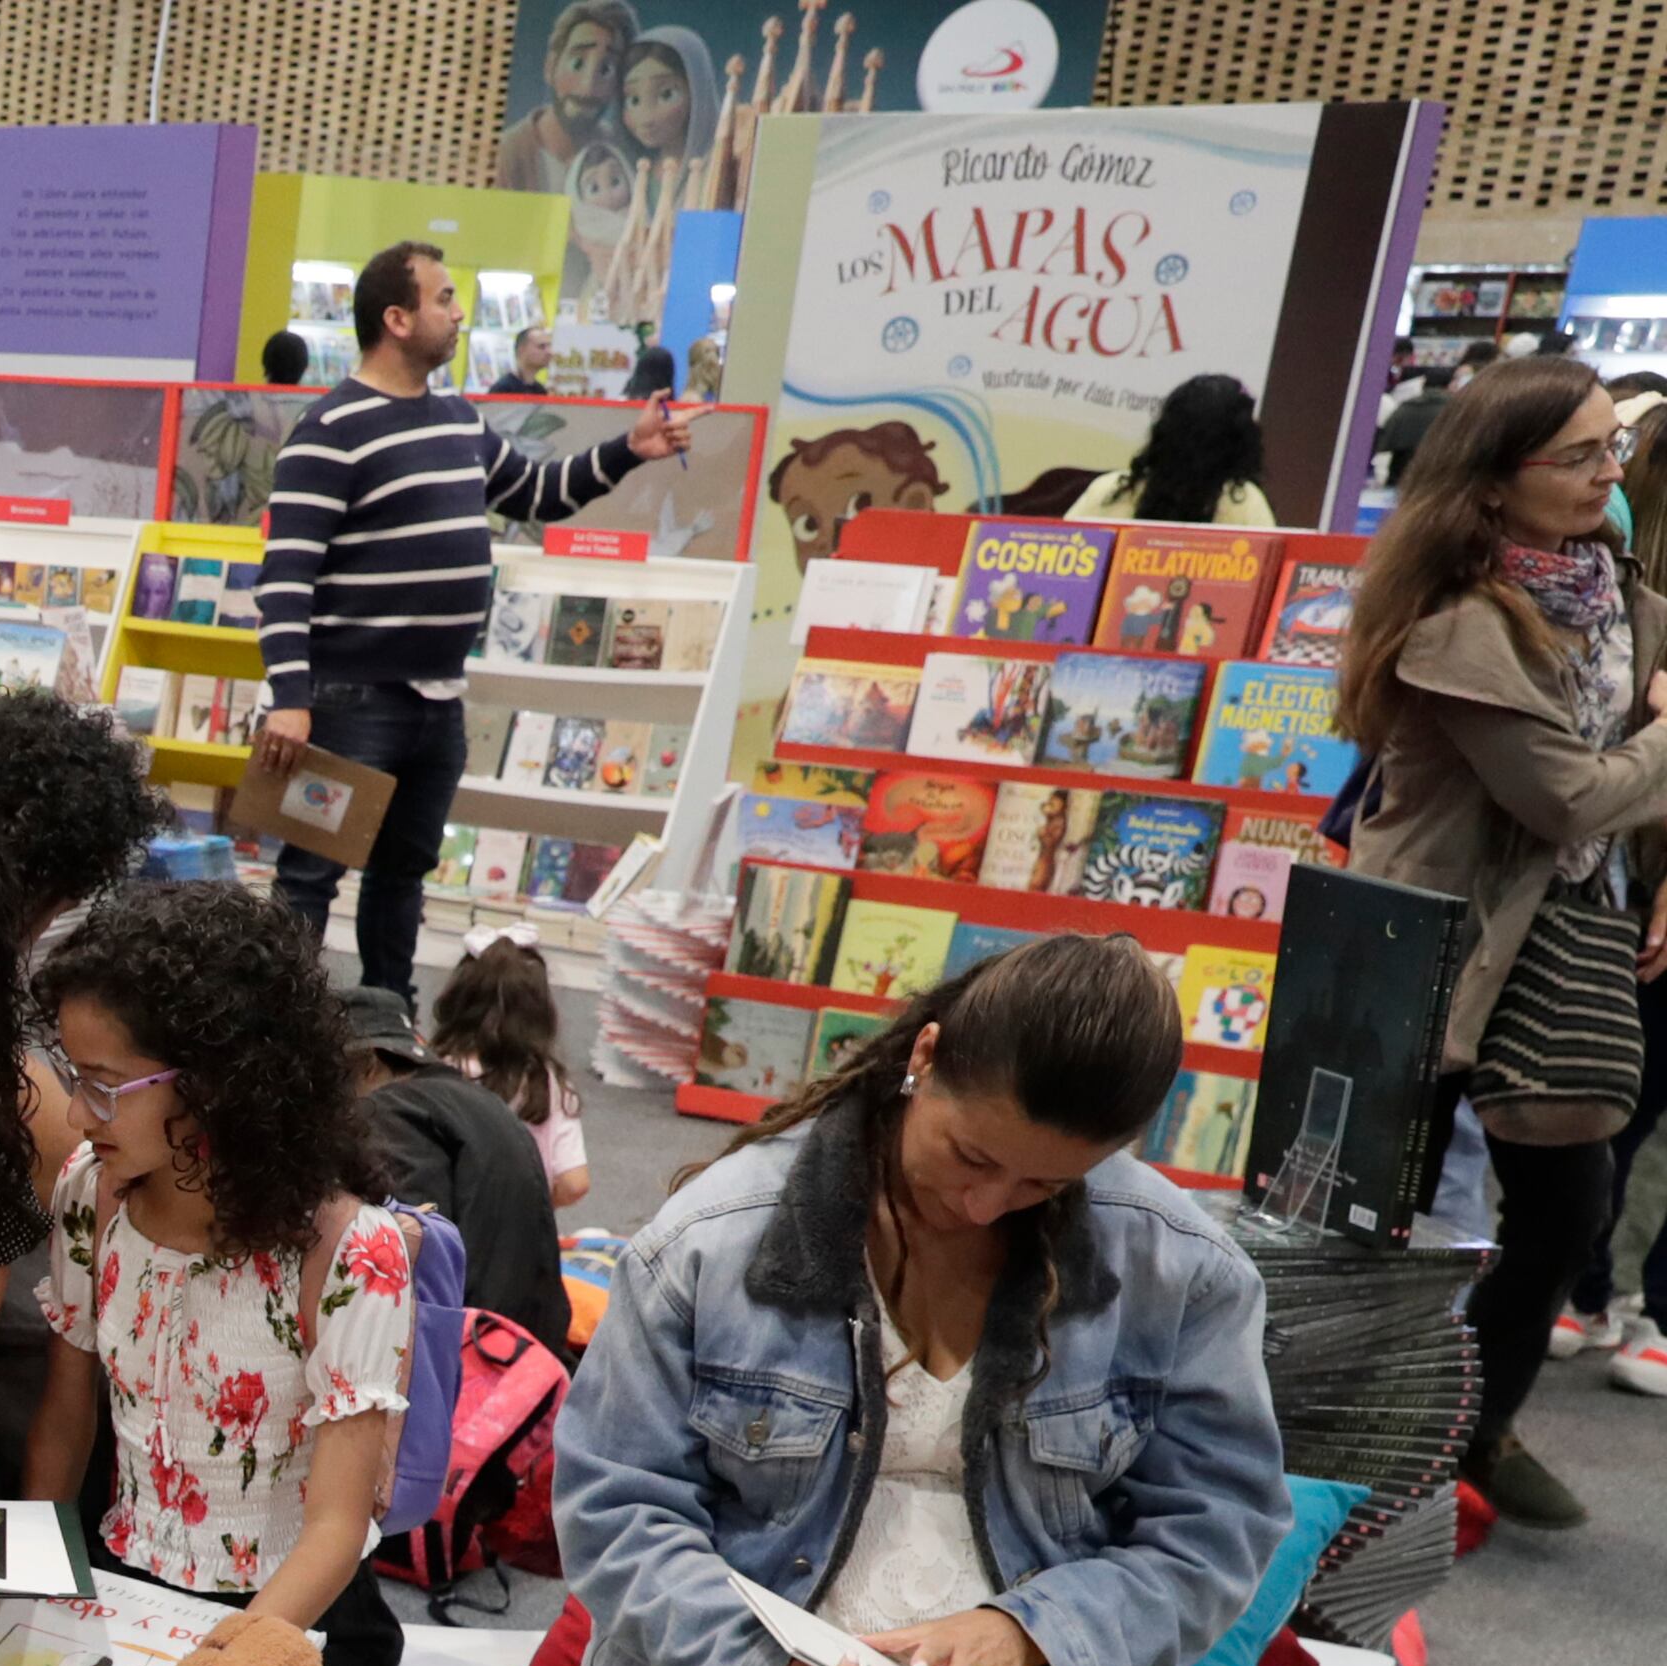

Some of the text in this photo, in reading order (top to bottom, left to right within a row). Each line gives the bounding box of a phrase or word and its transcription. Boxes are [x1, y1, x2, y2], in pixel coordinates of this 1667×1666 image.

[942, 143, 1156, 189] Ricardo Gómez
[837, 206, 1151, 296] LOS MAPAS
[943, 285, 1185, 358] DEL AGUA
[976, 538, 1099, 577] COSMOS
[1122, 546, 1260, 580] RELATIVIDAD
[1218, 704, 1342, 738] MAGNETISM
[1239, 815, 1327, 849] NUNCA
